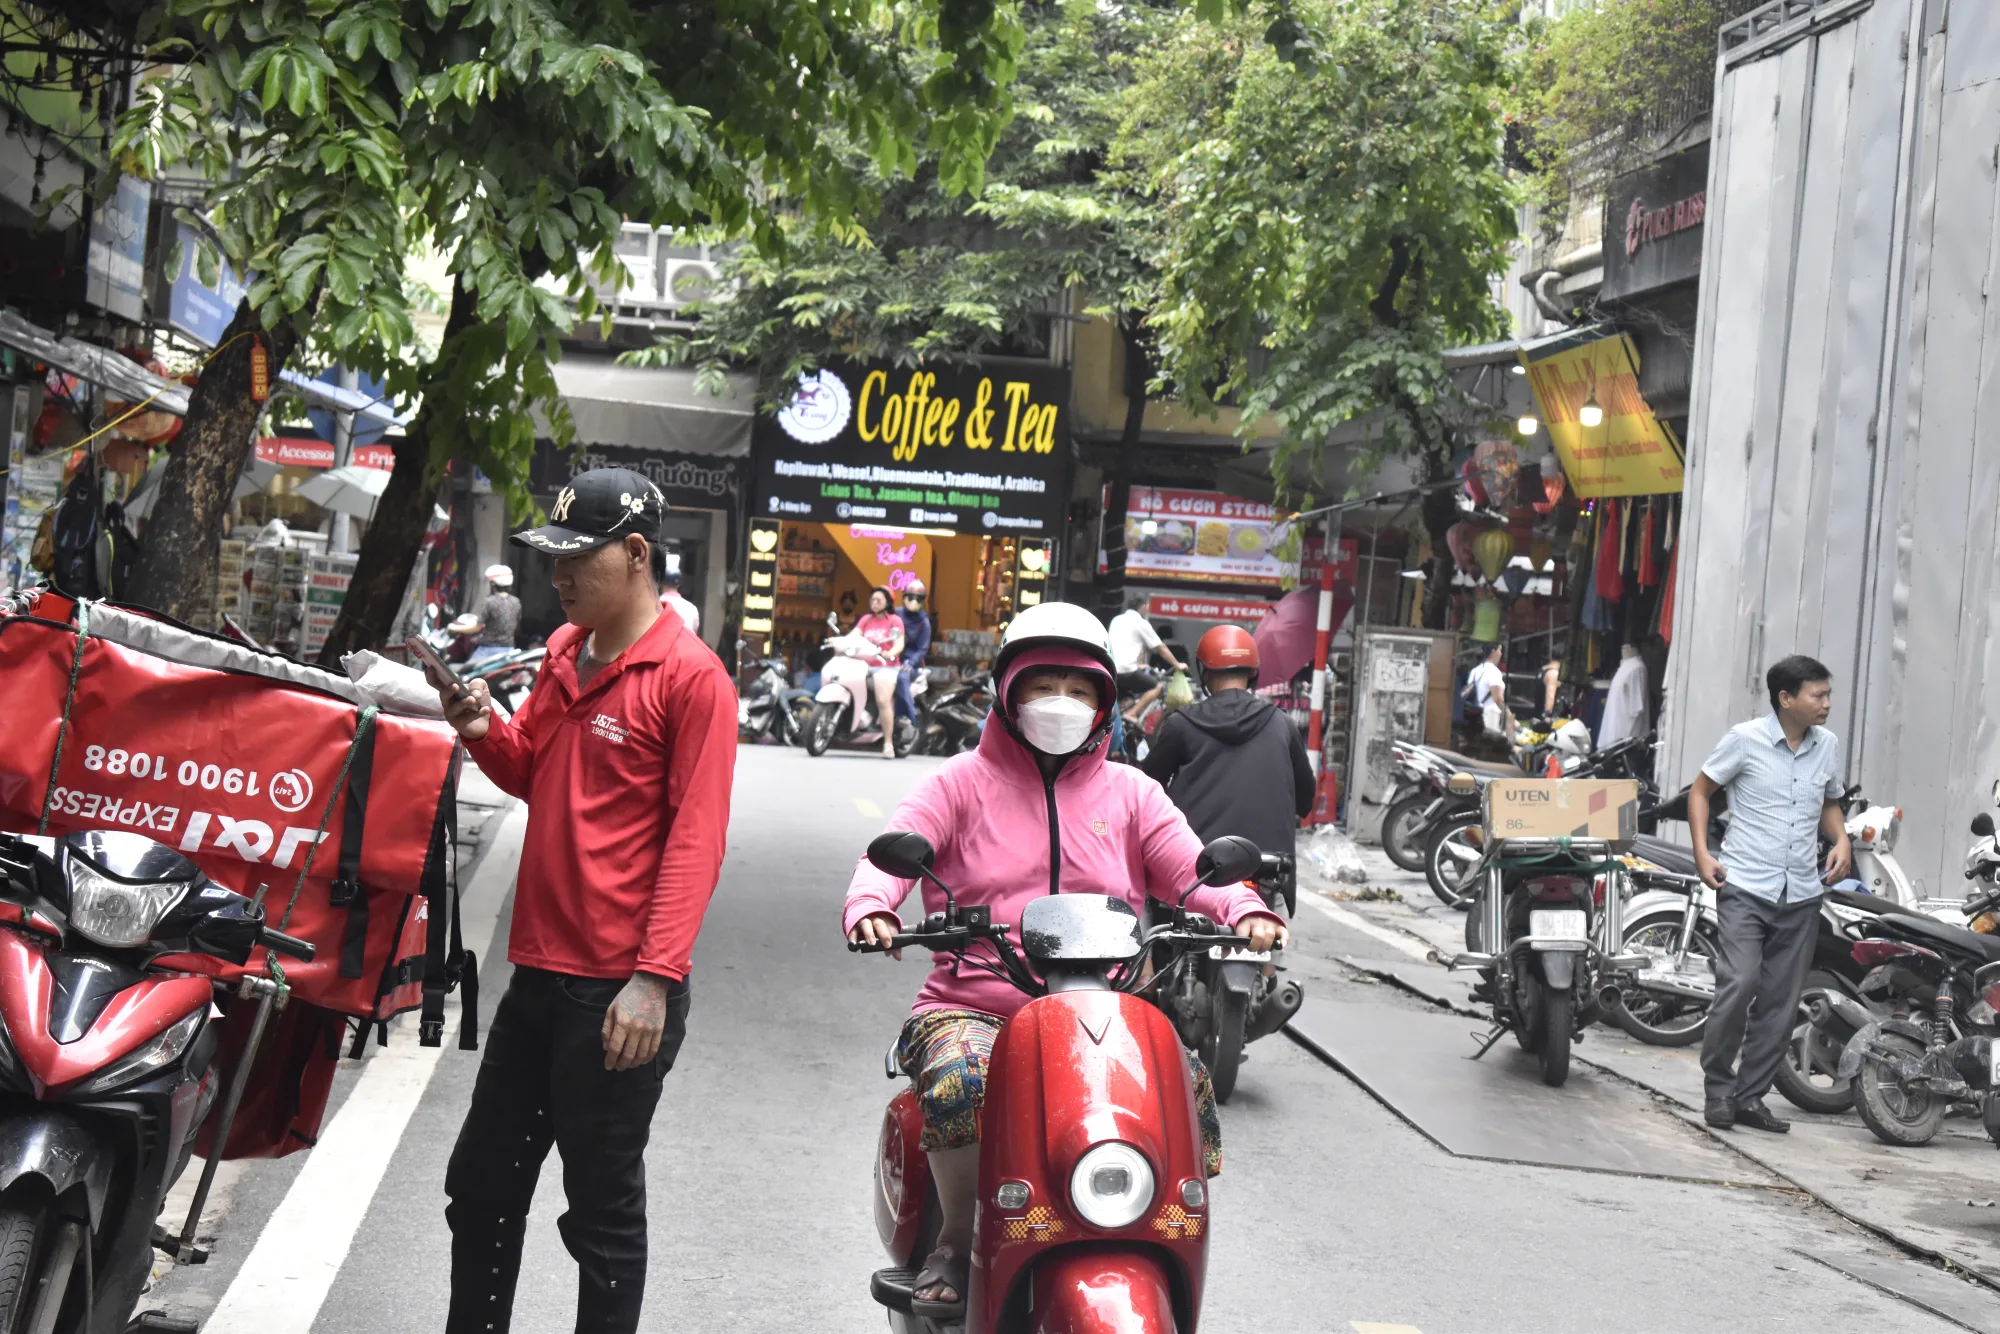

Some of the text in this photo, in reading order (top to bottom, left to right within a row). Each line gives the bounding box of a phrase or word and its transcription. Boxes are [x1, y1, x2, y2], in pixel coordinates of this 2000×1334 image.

[857, 370, 1058, 462] Coffee & Tea
[1004, 475, 1046, 493] Arabica
[821, 482, 851, 499] Lotus
[876, 486, 924, 503] Jasmine
[308, 604, 338, 617] OPEN
[591, 713, 618, 729] J&T
[84, 744, 260, 796] 1900 1088
[274, 786, 292, 796] 24/7
[1505, 789, 1550, 802] UTEN
[49, 786, 180, 832] EXPRESS
[1506, 818, 1523, 830] 86
[71, 958, 112, 972] HONDA
